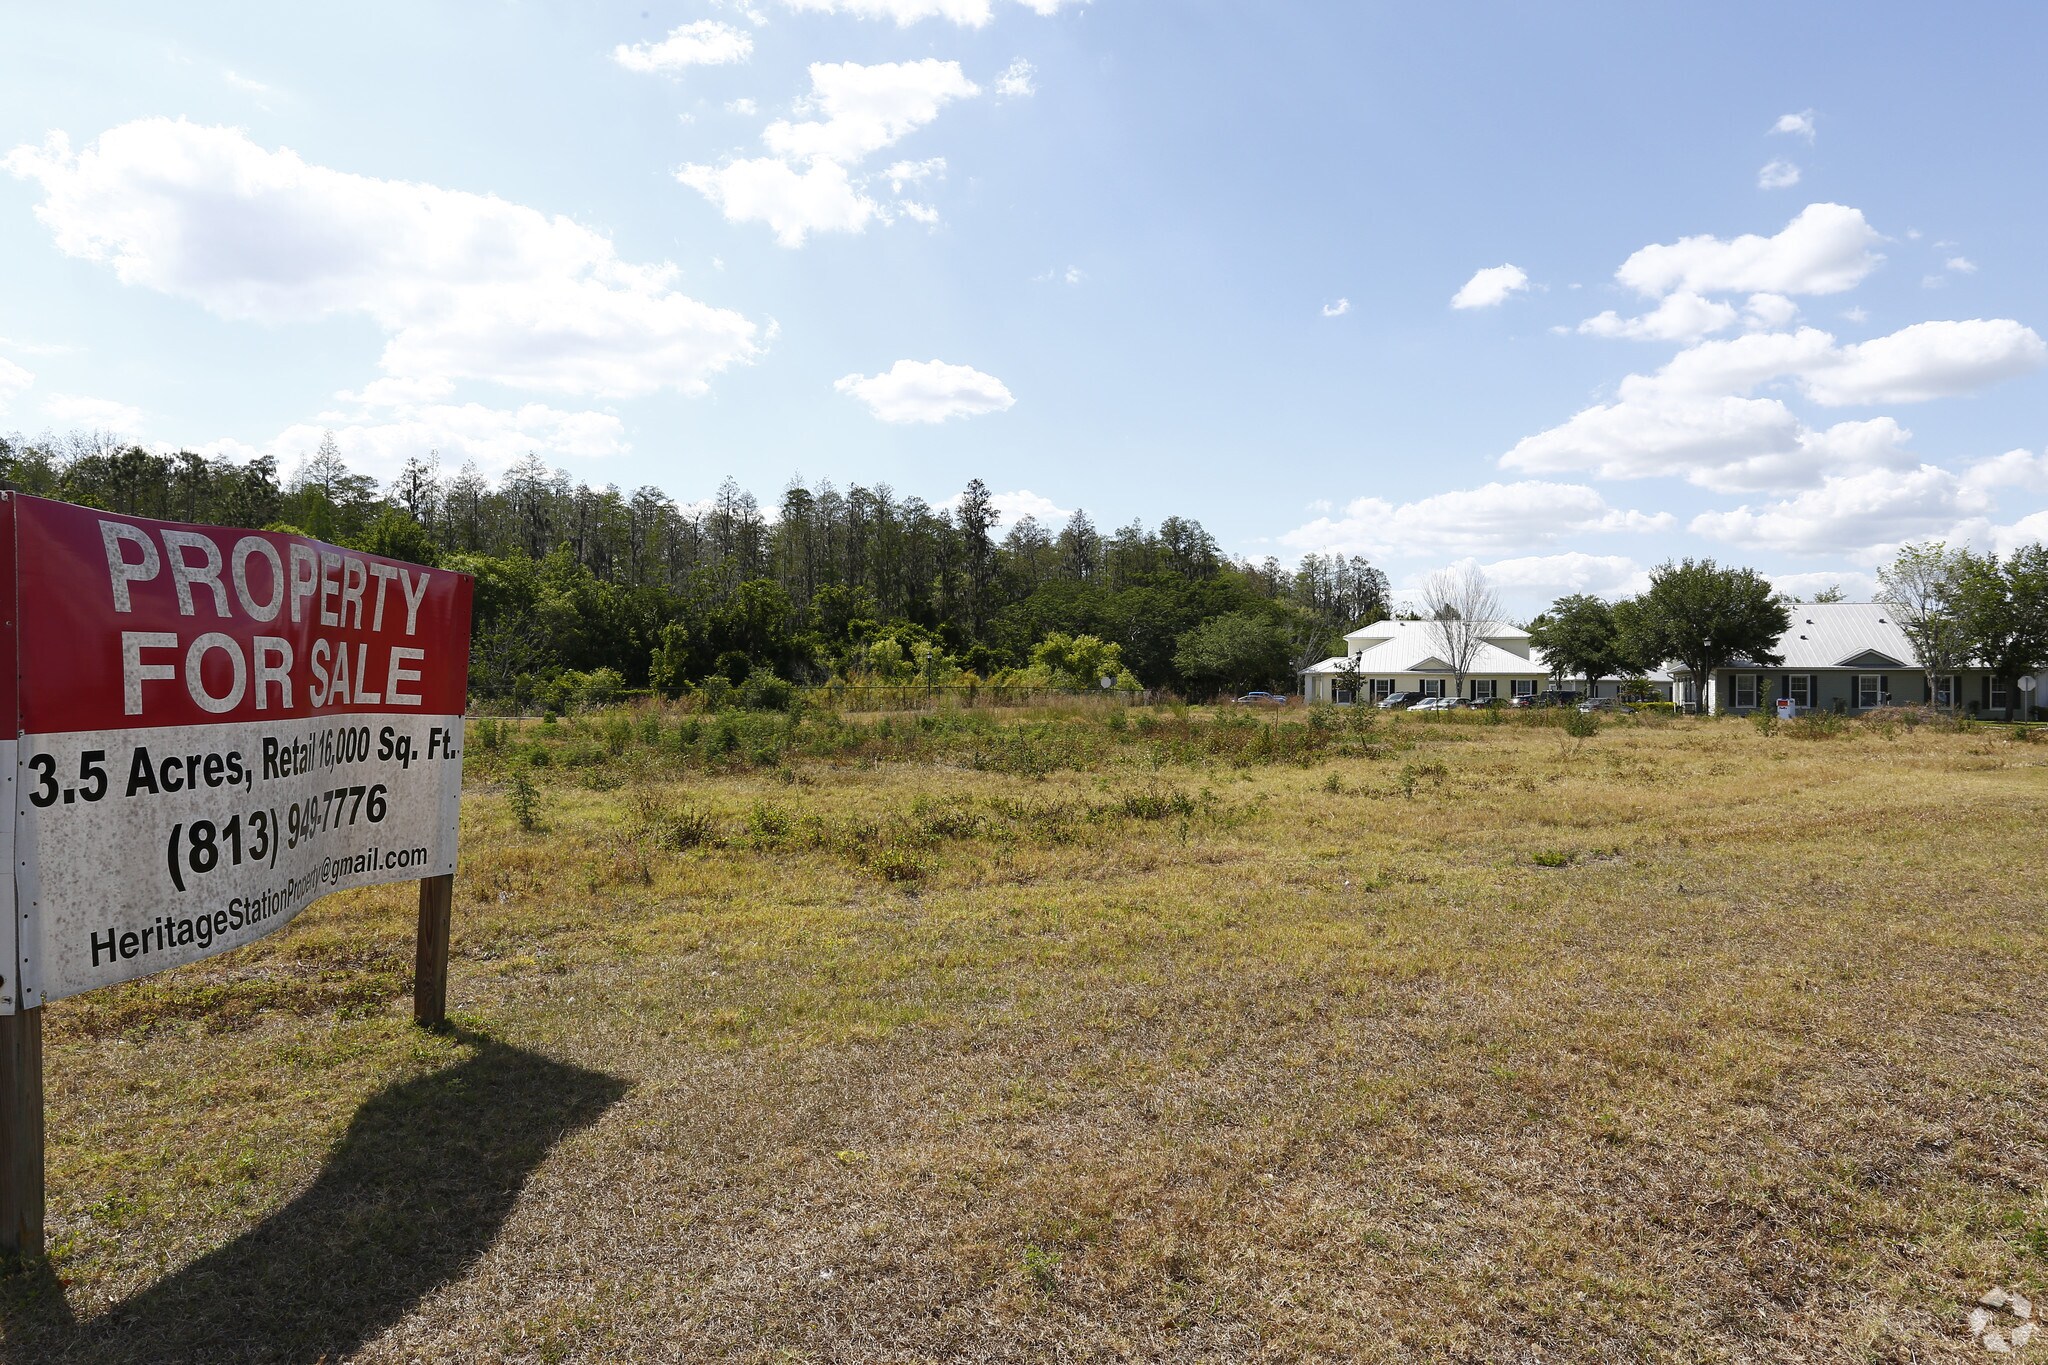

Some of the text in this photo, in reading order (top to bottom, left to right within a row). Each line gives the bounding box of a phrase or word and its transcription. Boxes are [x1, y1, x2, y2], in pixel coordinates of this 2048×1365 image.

[98, 520, 430, 635] PROPERTY
[122, 631, 424, 715] FOR SALE
[29, 726, 456, 807] 3.5 Acres, Retail 16,000 Sq. Ft.
[167, 784, 387, 891] (813) 949-7776
[91, 846, 427, 967] HeritageStationProperty@gmail.com
